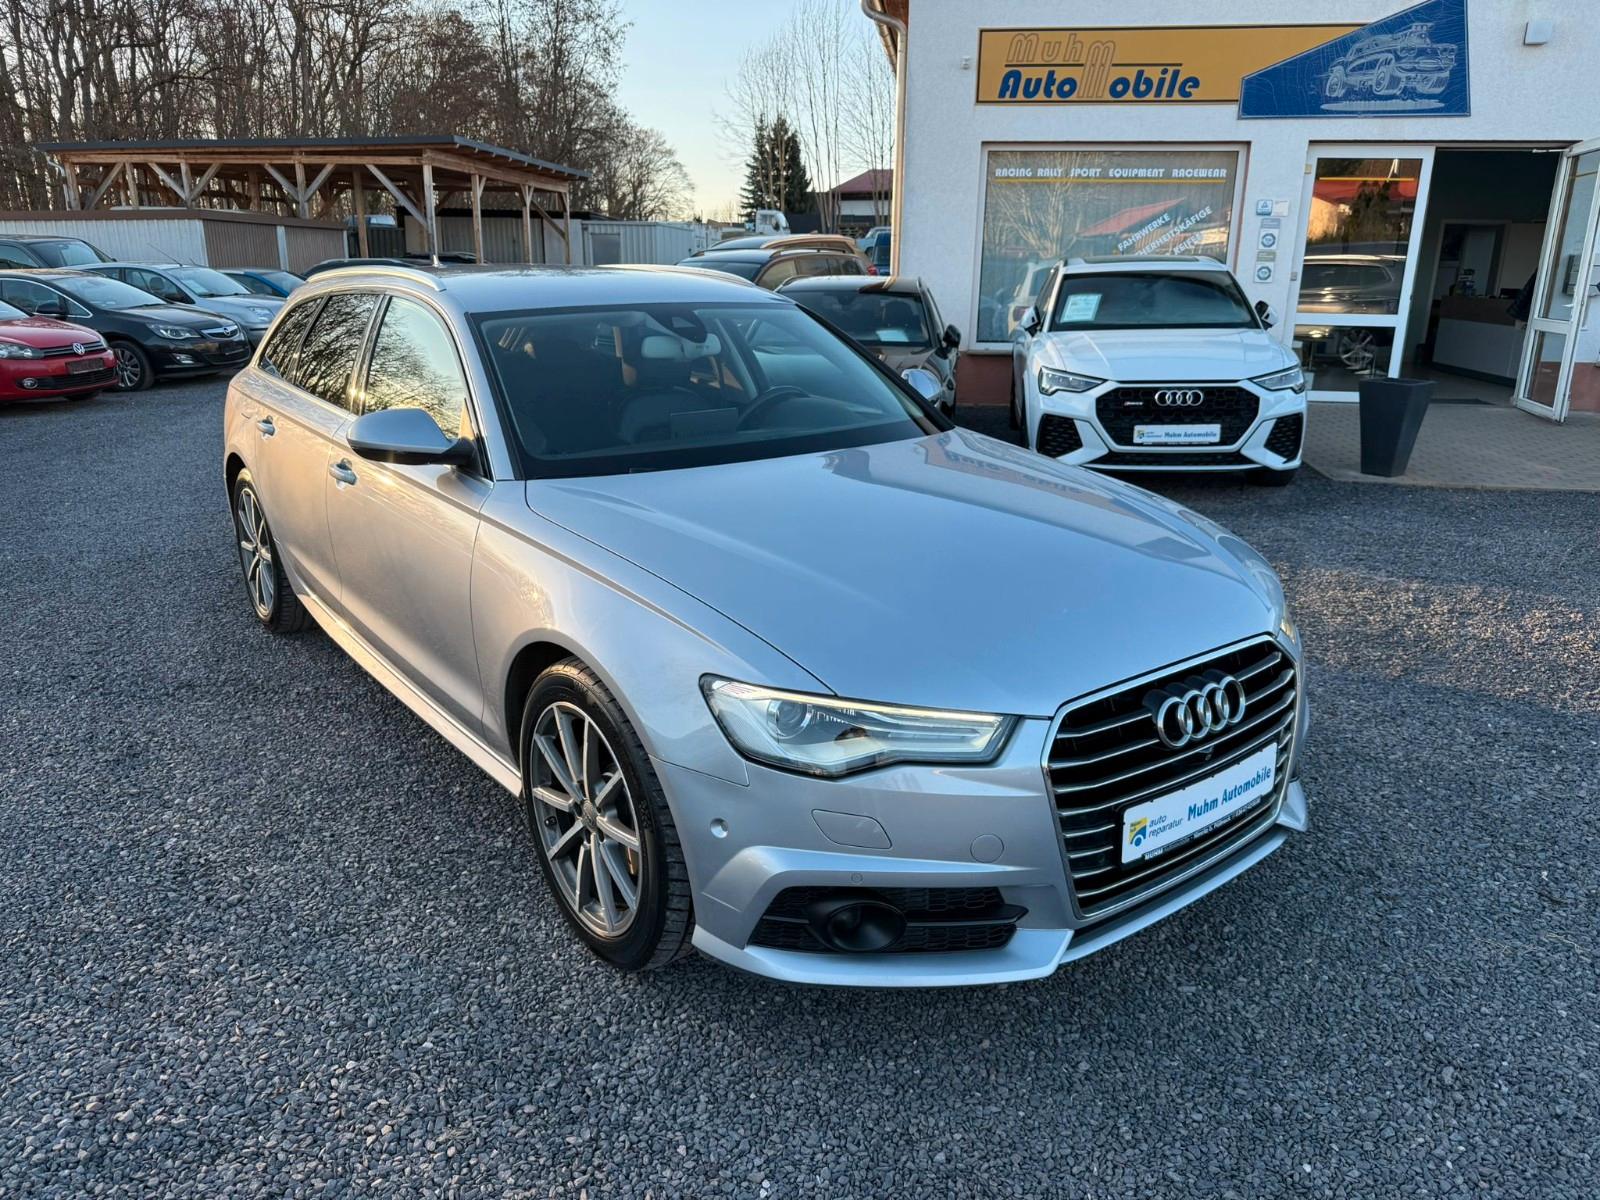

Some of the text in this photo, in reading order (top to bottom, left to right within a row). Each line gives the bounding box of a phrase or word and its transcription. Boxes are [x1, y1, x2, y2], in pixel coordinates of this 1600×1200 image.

[995, 167, 1228, 178] RACING RALLY SPORT EQUIPMENT RACEWEAR
[1118, 213, 1170, 252] FAHRWERKE
[1187, 797, 1218, 821] Muhm
[1221, 766, 1271, 805] Automobile
[1148, 817, 1184, 838] reparatur
[1149, 814, 1167, 828] auto
